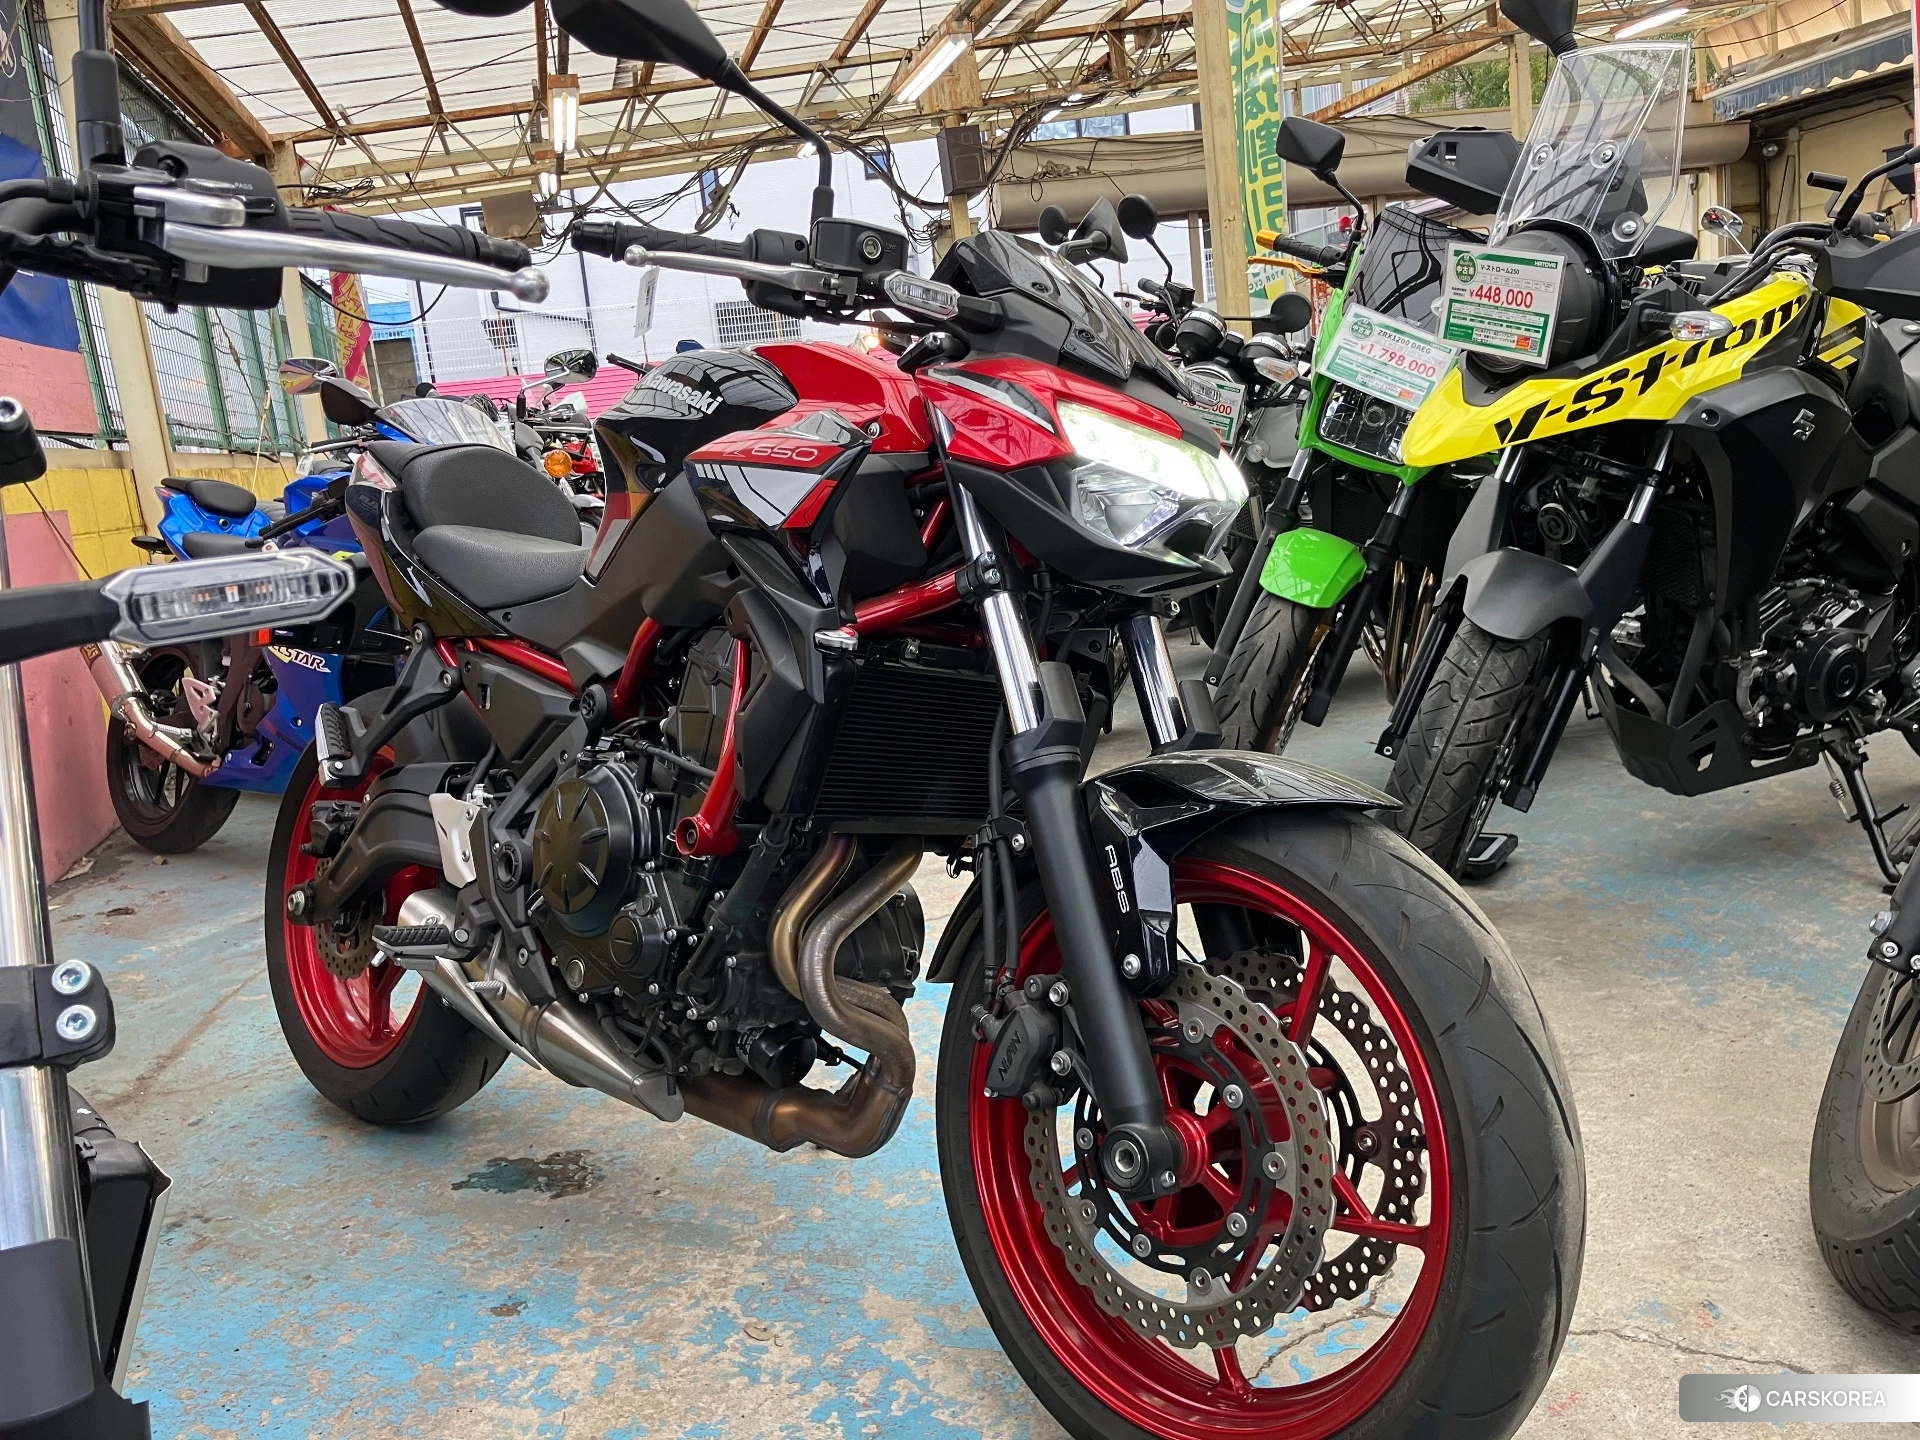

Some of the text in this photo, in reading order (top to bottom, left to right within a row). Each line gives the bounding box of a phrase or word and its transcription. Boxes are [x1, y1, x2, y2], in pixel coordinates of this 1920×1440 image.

[234, 182, 253, 190] PASS
[1469, 284, 1534, 309] ¥448,000
[1377, 329, 1411, 347] ZRX1200
[1411, 342, 1431, 354] DAEG
[1360, 343, 1437, 378] ¥1,798,000
[642, 369, 724, 415] Kawasaki
[270, 645, 325, 670] STAR
[1105, 844, 1130, 914] ABS
